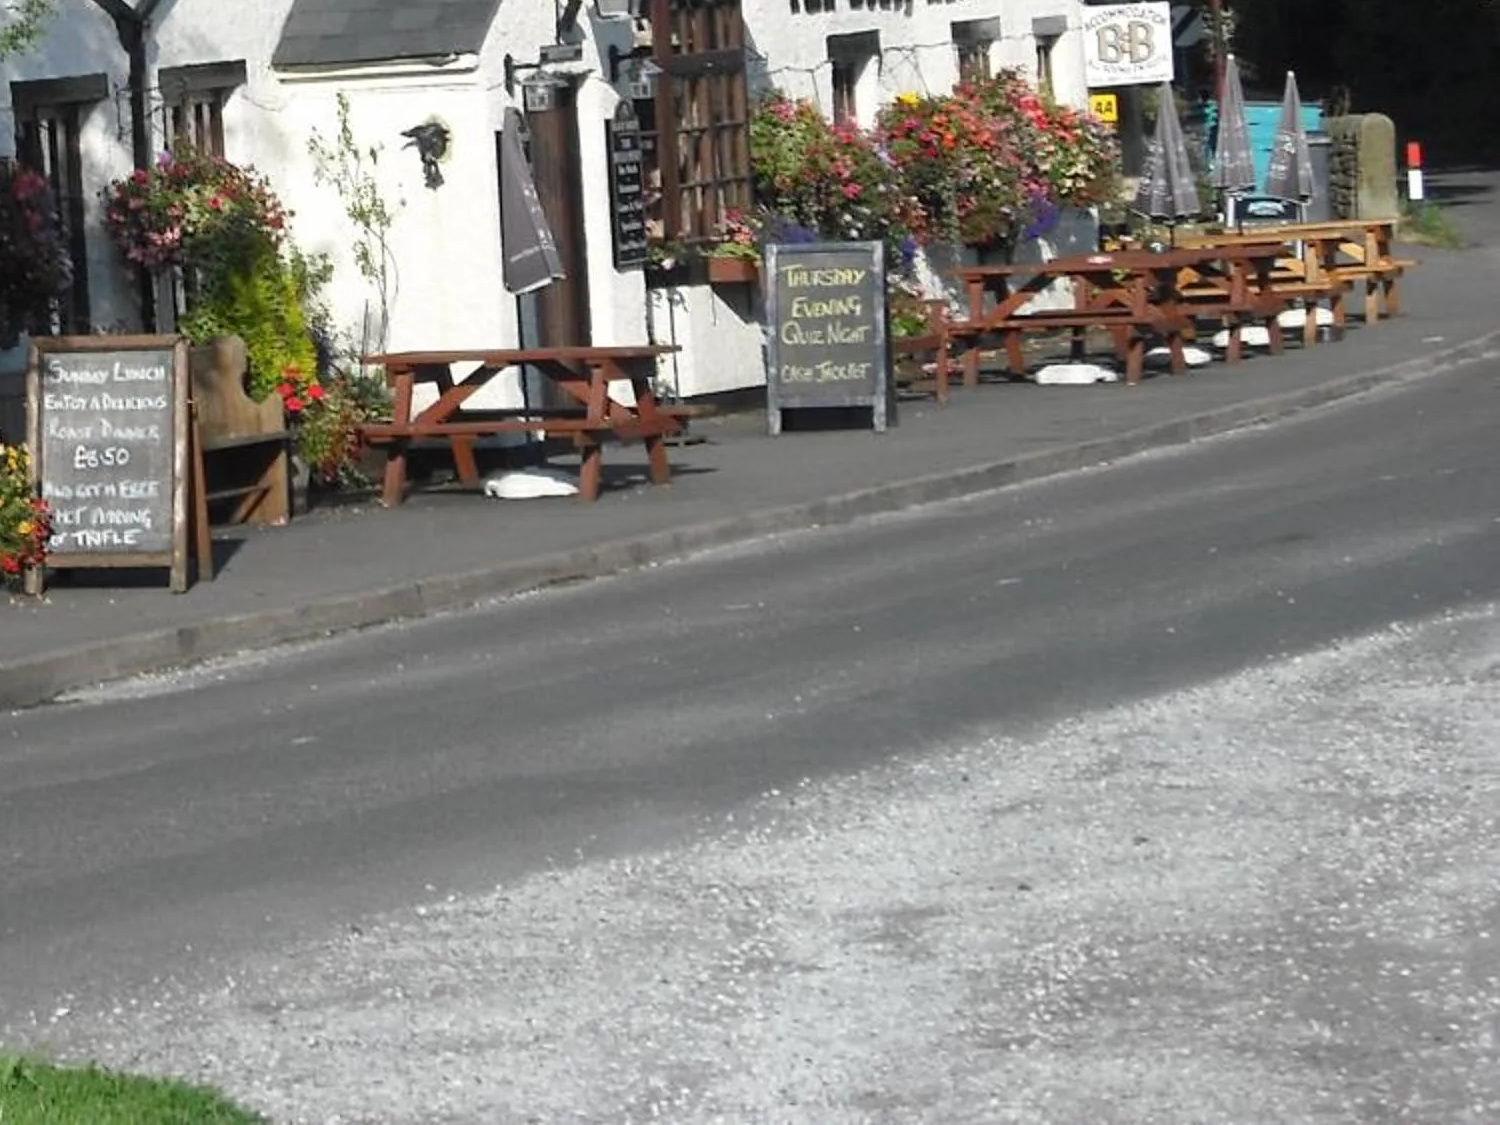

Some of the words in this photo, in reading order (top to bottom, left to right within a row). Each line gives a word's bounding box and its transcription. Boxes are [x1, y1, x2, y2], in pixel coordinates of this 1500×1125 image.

[1095, 100, 1114, 113] AA
[780, 263, 865, 288] THURSDAY
[791, 295, 862, 318] EVENING
[781, 319, 825, 345] QUIZ
[827, 321, 870, 346] NIGHT
[113, 361, 165, 382] LUNCH
[70, 527, 143, 549] TRIFLE
